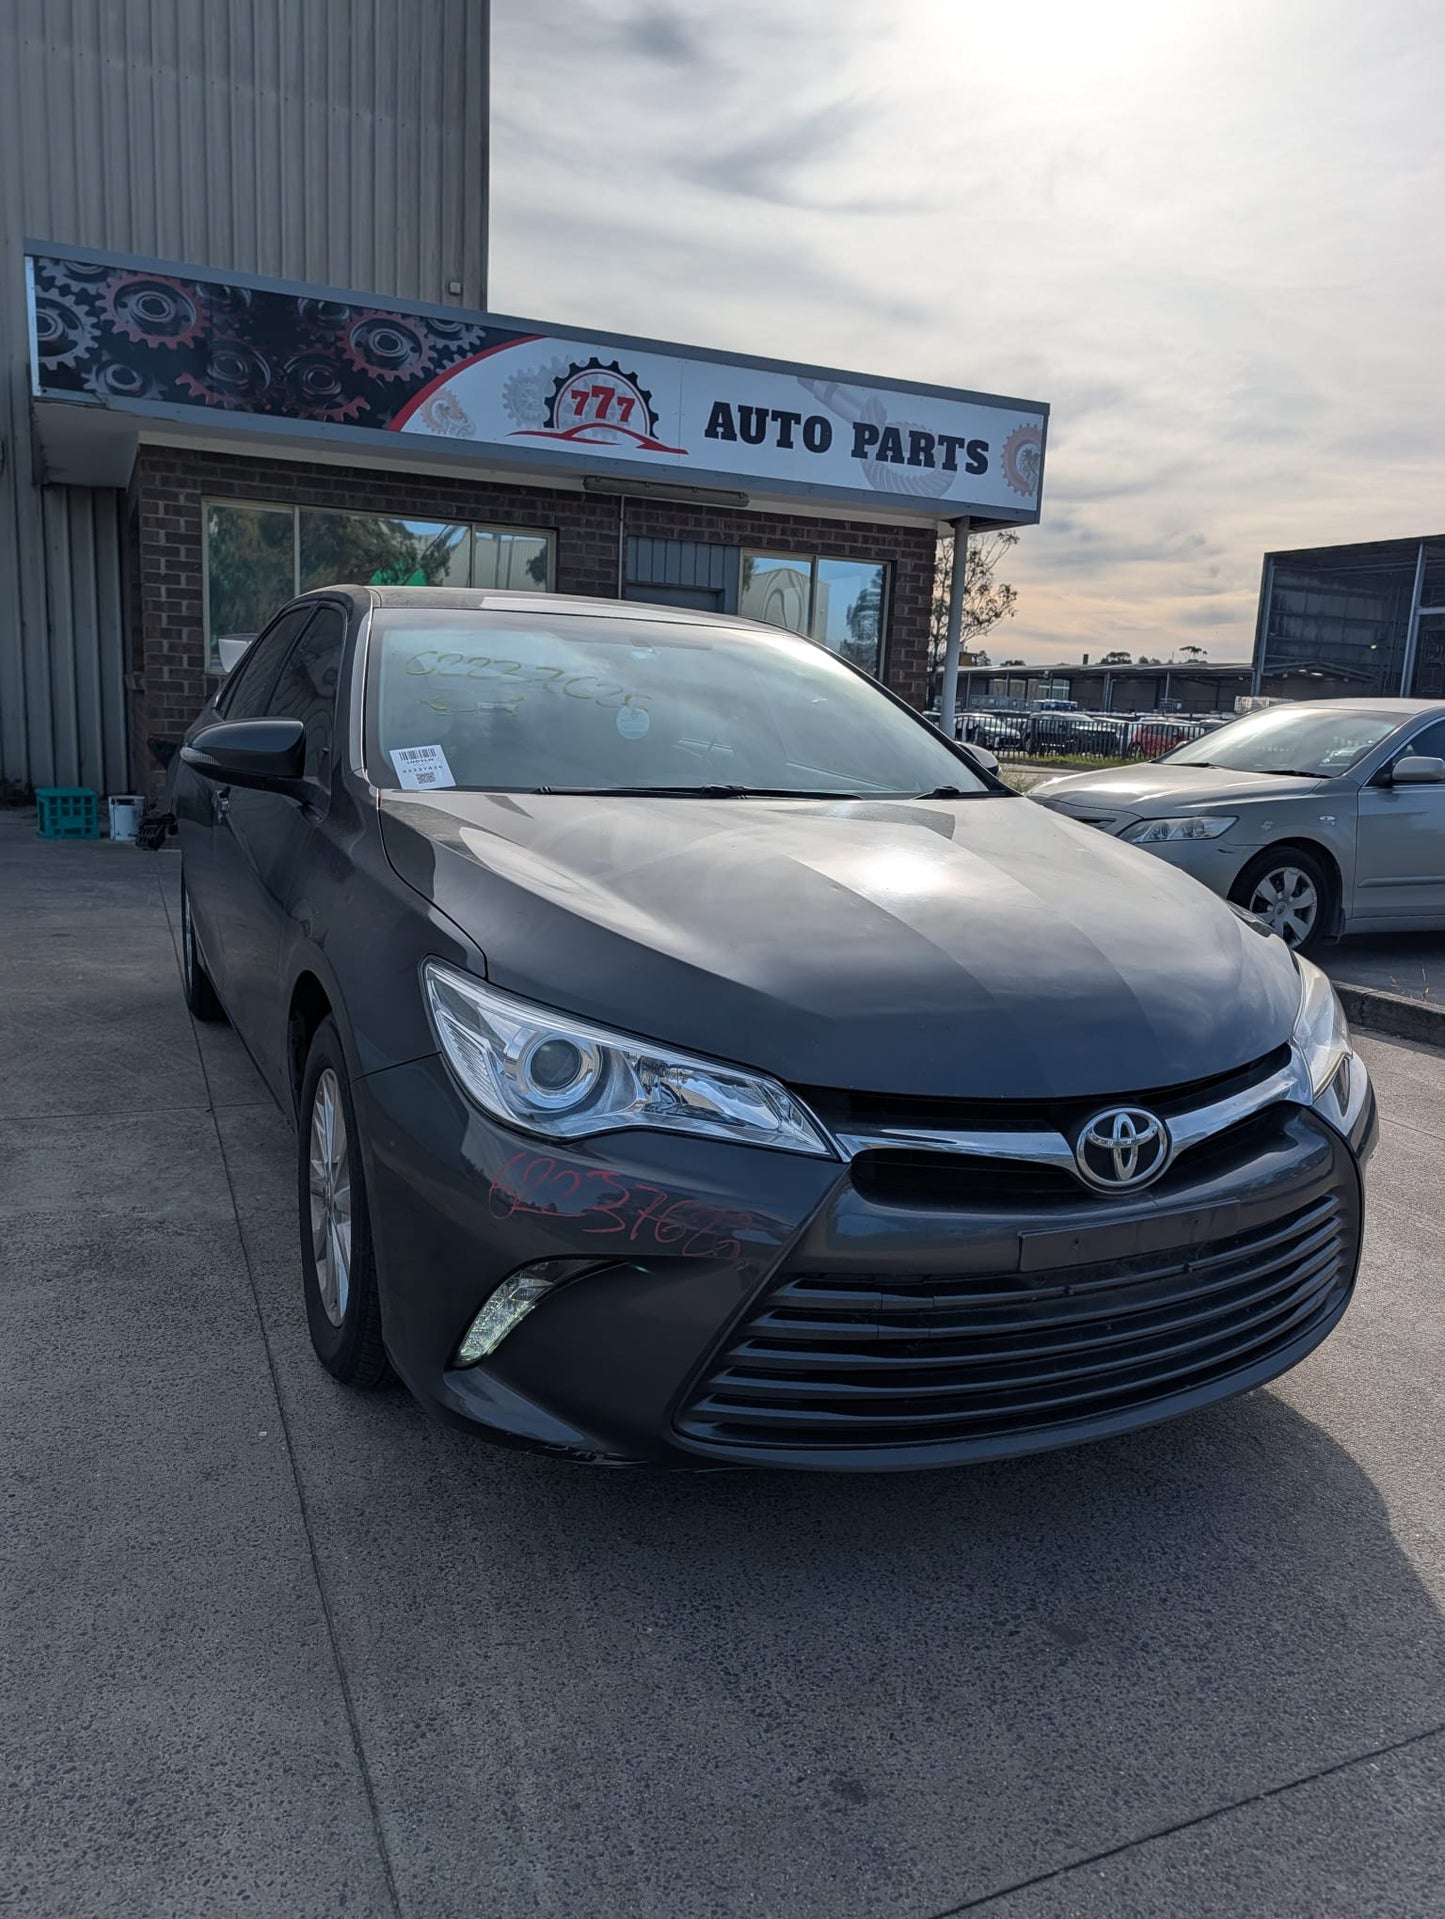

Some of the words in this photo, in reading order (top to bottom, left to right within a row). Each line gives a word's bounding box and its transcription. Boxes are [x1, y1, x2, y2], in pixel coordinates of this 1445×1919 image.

[571, 384, 636, 423] 777
[704, 401, 833, 453] AUTO
[851, 421, 990, 475] PARTS
